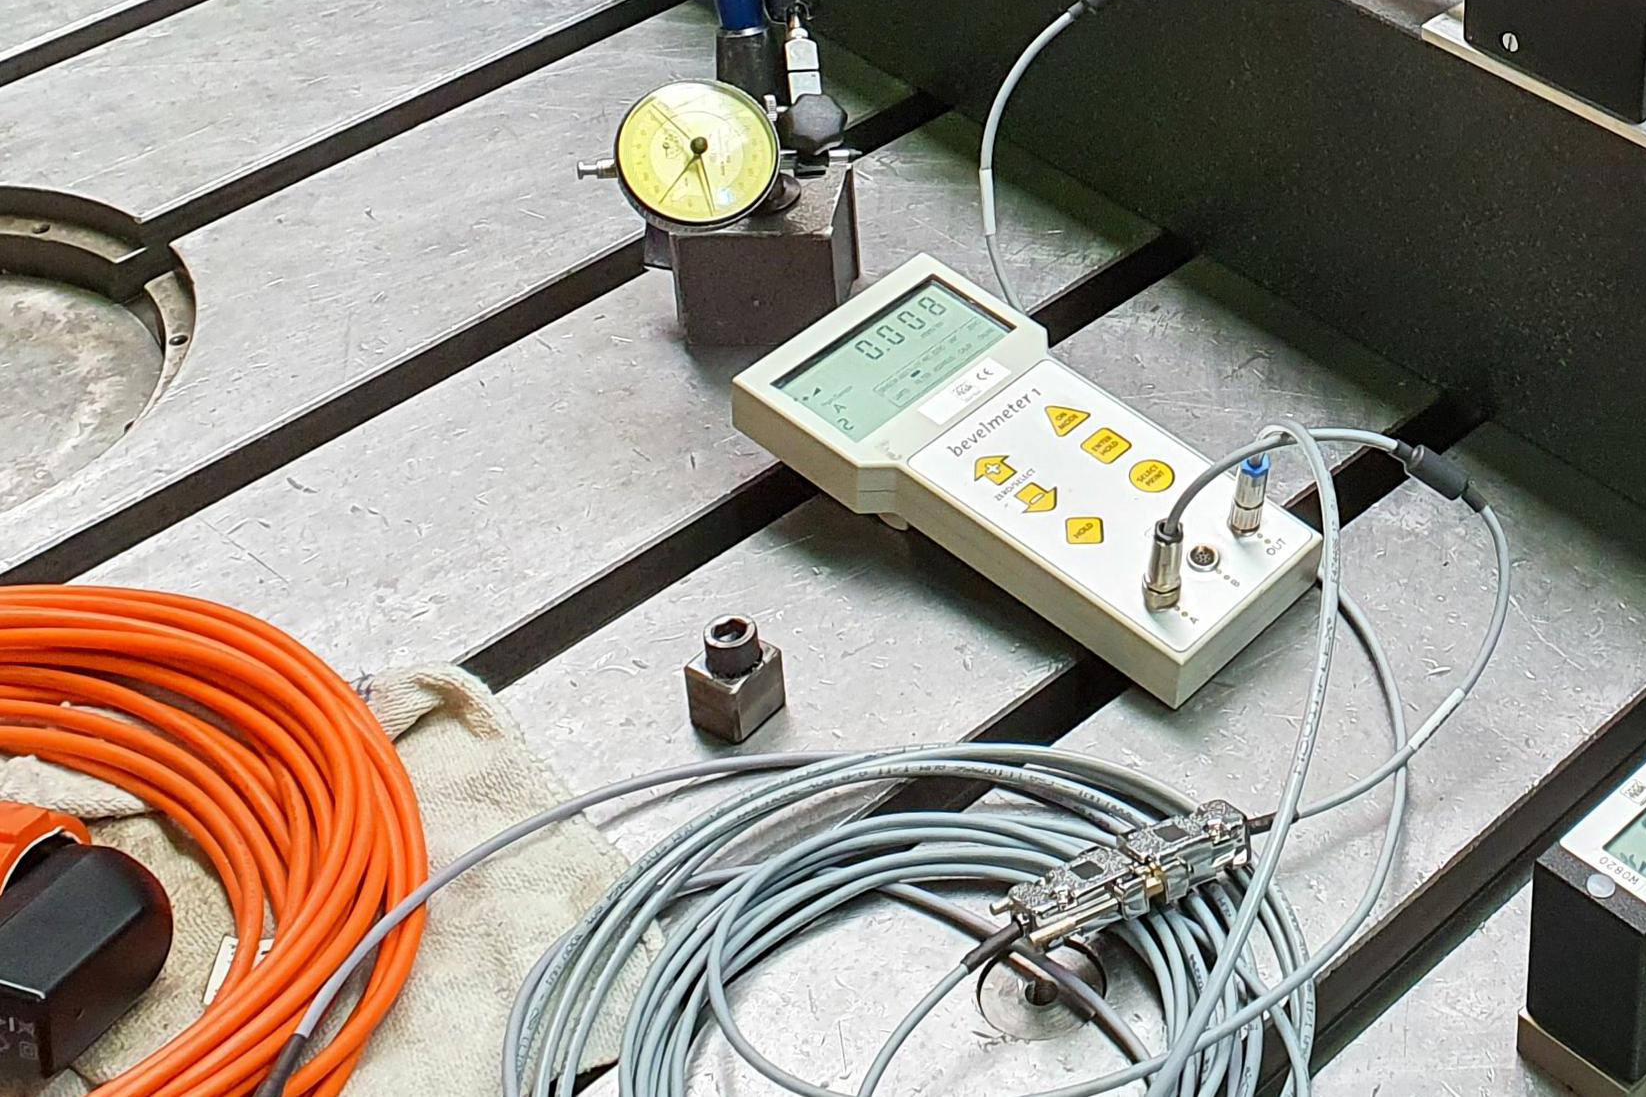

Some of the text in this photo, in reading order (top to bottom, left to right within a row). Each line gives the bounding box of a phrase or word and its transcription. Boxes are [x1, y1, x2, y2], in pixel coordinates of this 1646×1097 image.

[947, 387, 1043, 458] bevelmeter 1
[1136, 464, 1158, 484] SELECT
[1073, 522, 1094, 539] HOLD
[1266, 537, 1287, 557] OUT
